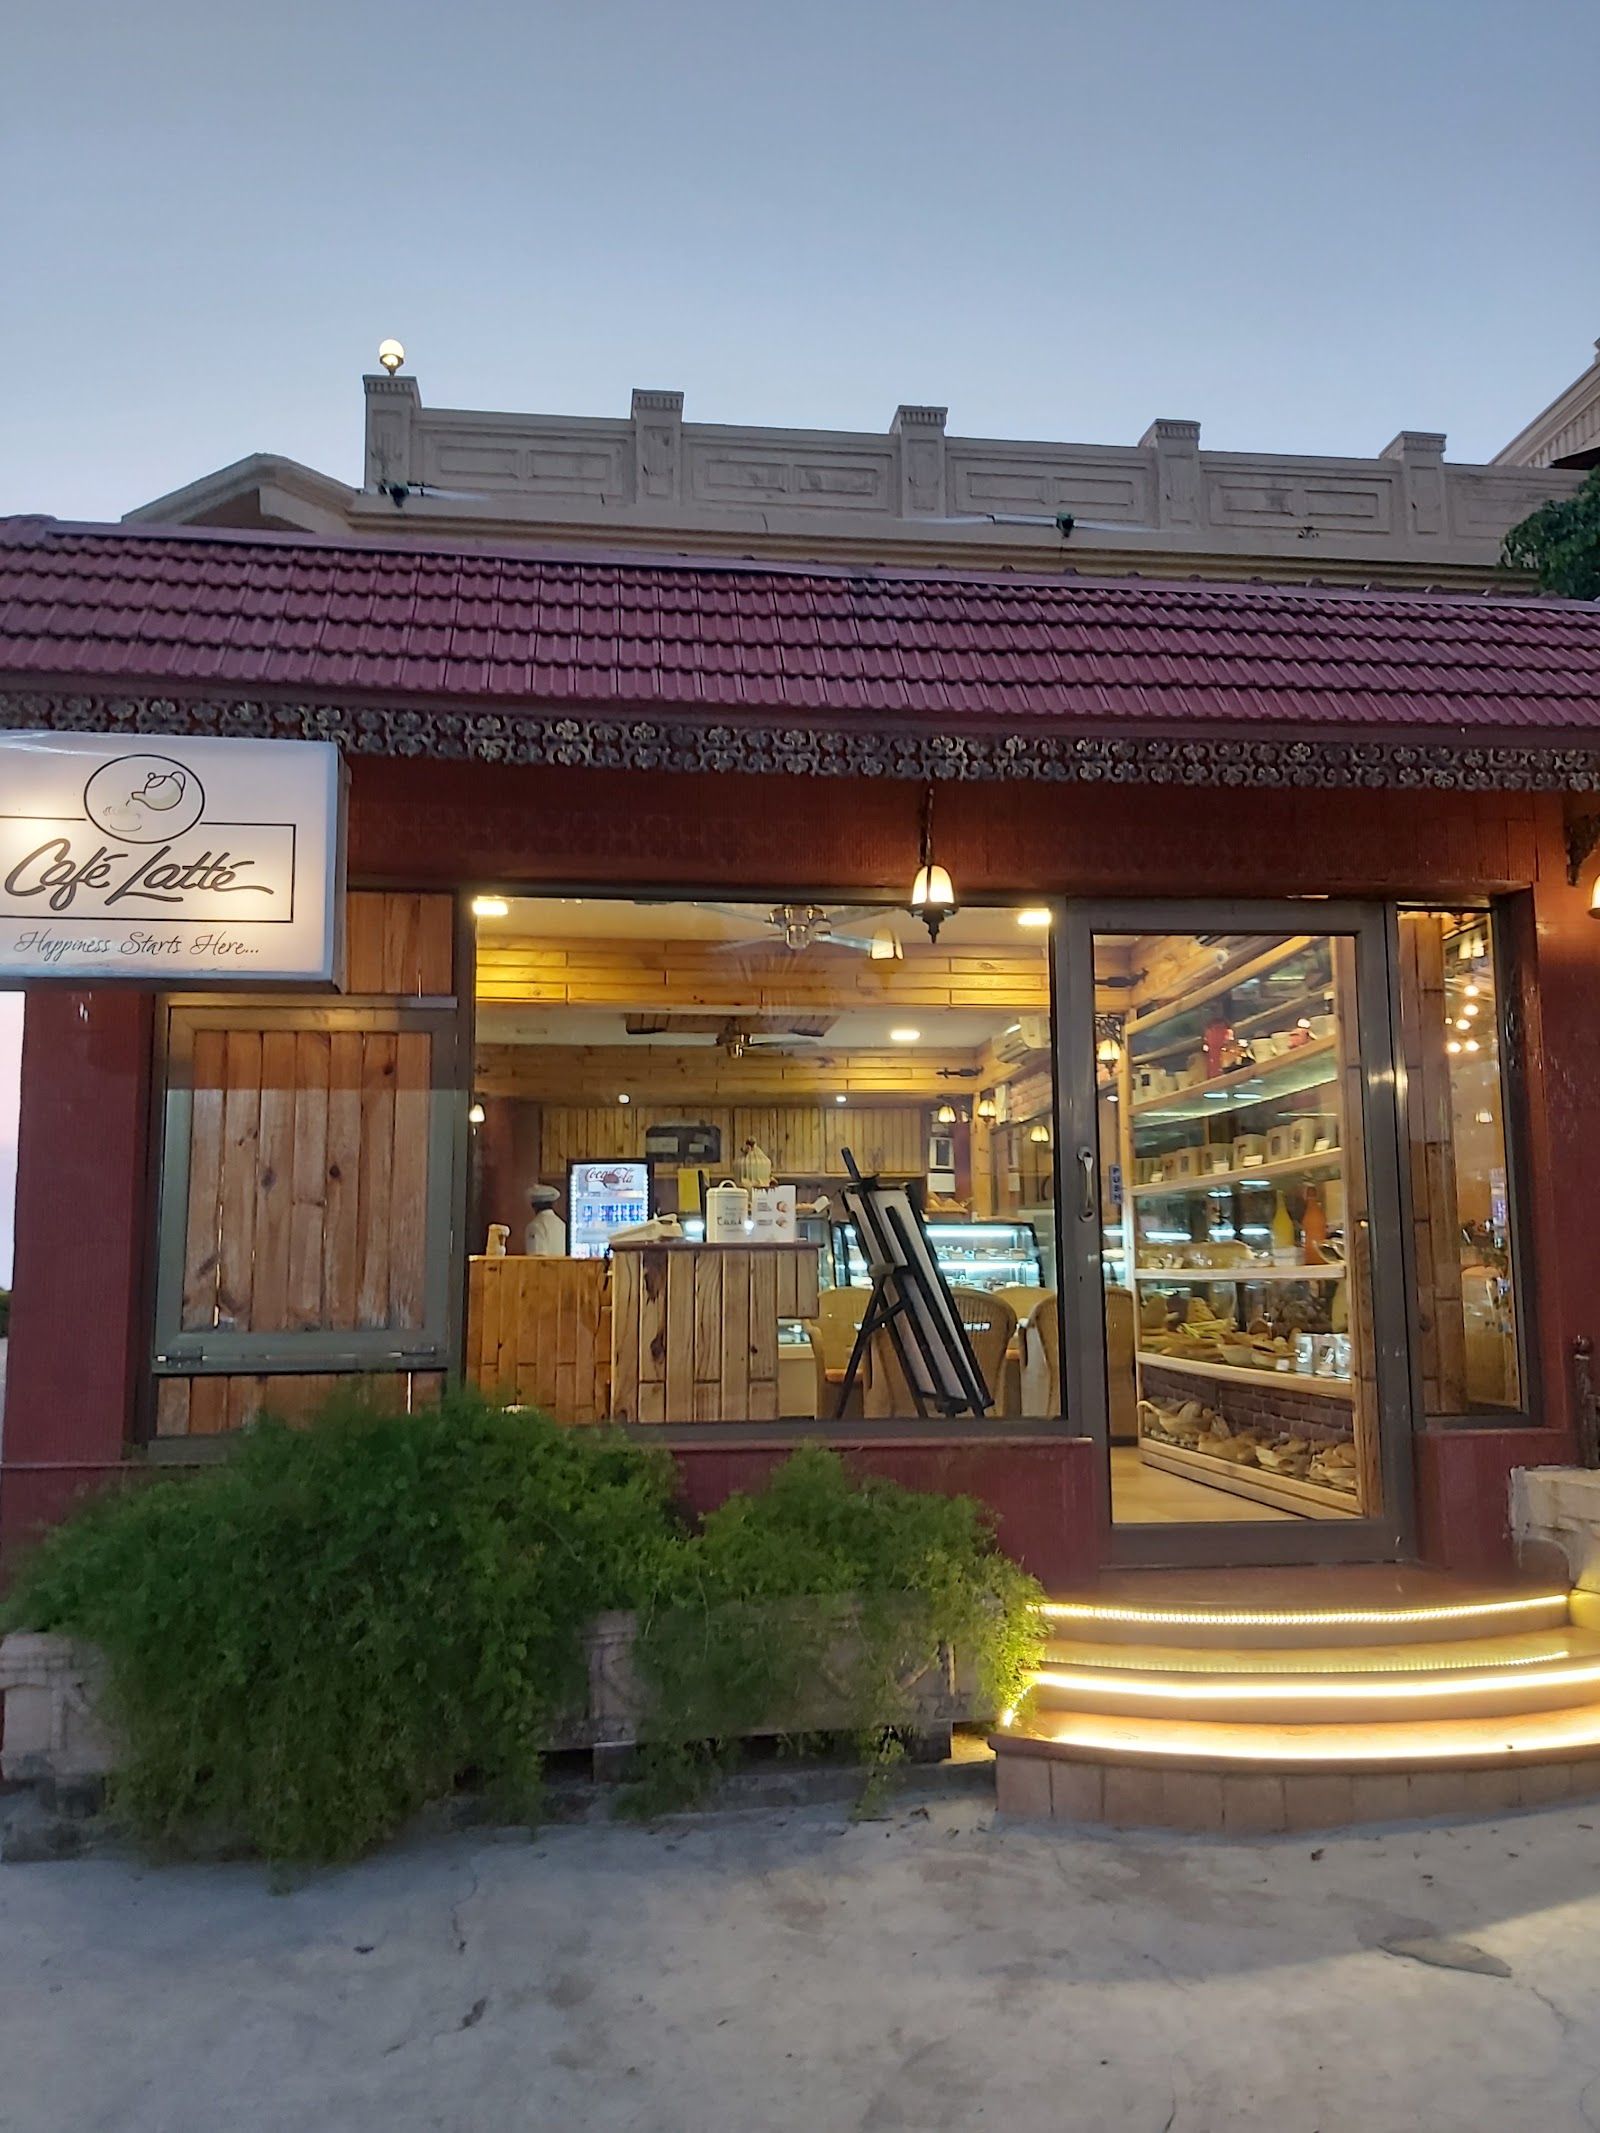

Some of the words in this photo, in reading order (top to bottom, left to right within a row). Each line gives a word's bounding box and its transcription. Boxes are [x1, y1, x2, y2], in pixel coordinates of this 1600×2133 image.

[5, 838, 128, 911] Café
[104, 846, 274, 906] Latté
[13, 928, 111, 962] Happiness
[120, 931, 182, 955] Starts
[189, 930, 260, 956] Here...
